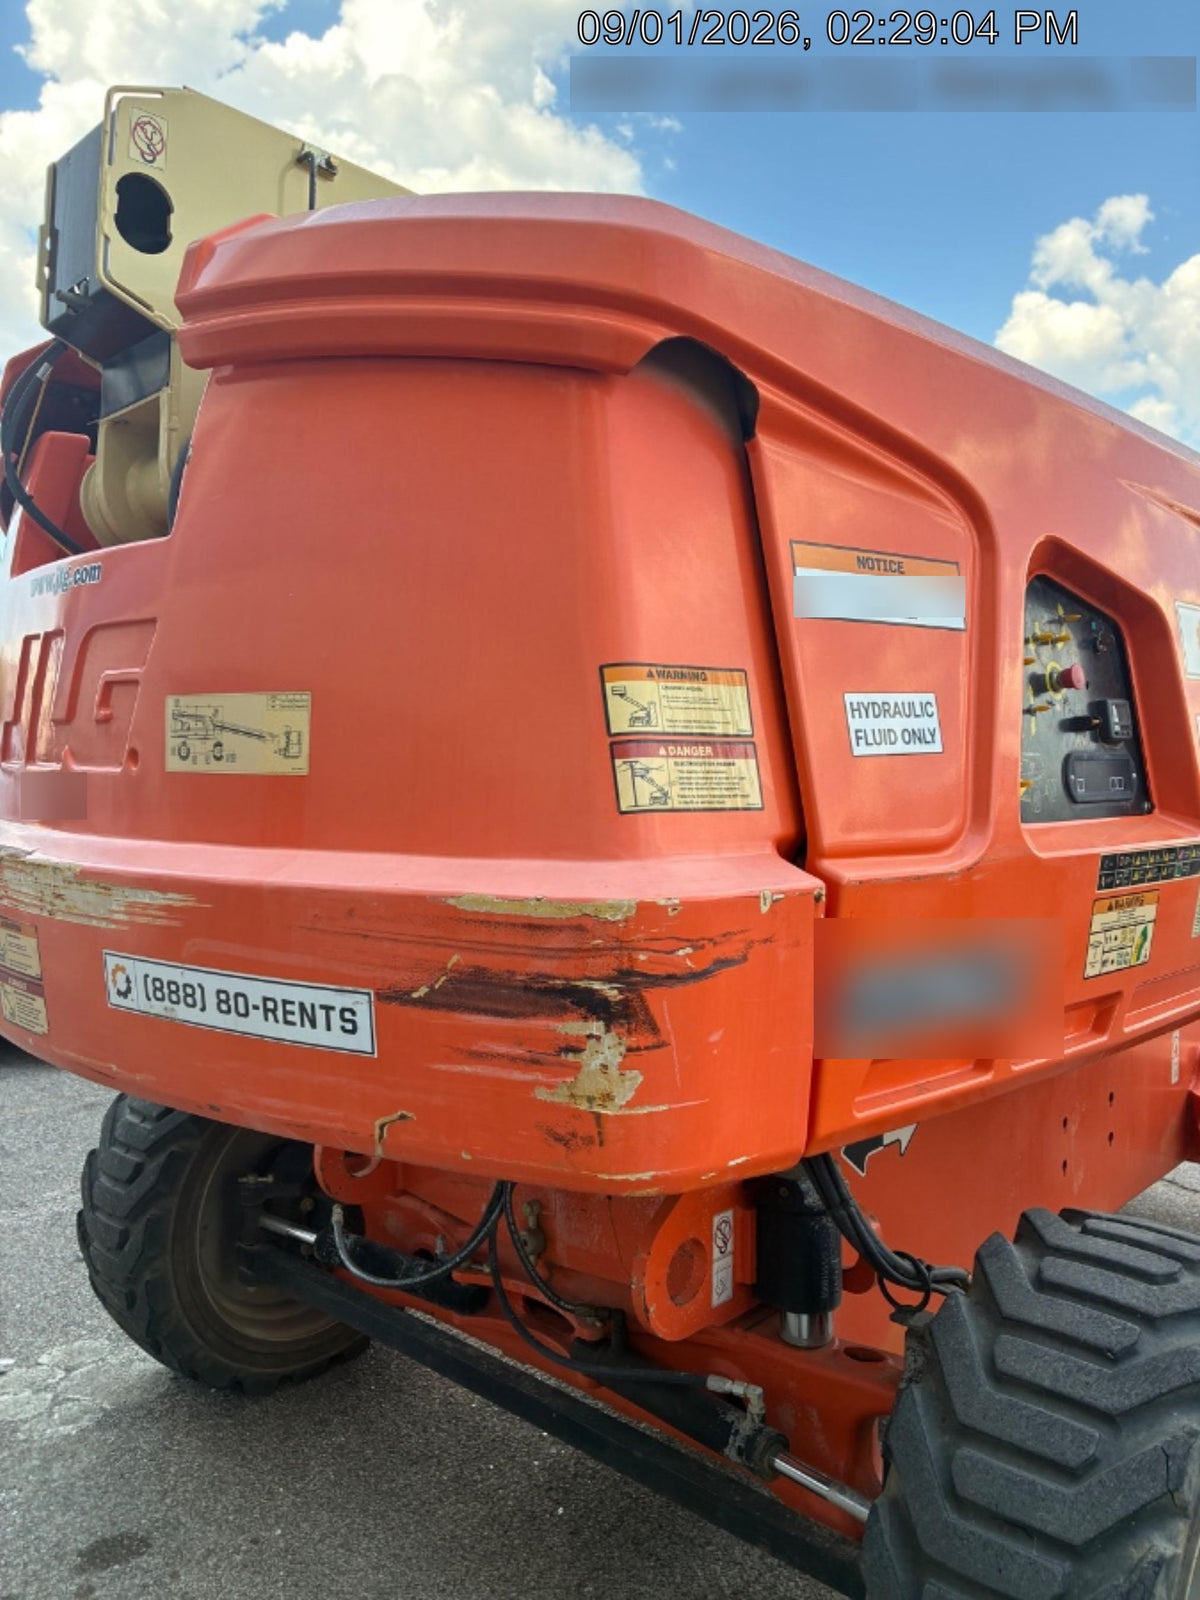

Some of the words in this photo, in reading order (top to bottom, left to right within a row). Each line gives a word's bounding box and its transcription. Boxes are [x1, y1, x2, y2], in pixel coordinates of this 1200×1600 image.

[856, 556, 905, 574] NOTICE
[656, 669, 708, 682] WARNING
[849, 702, 934, 719] HYDRAULIC
[855, 728, 898, 747] FLUID
[901, 727, 937, 745] ONLY
[668, 746, 713, 757] DANGER
[143, 973, 206, 1012] (888)
[216, 989, 358, 1035] 80-RENTS
